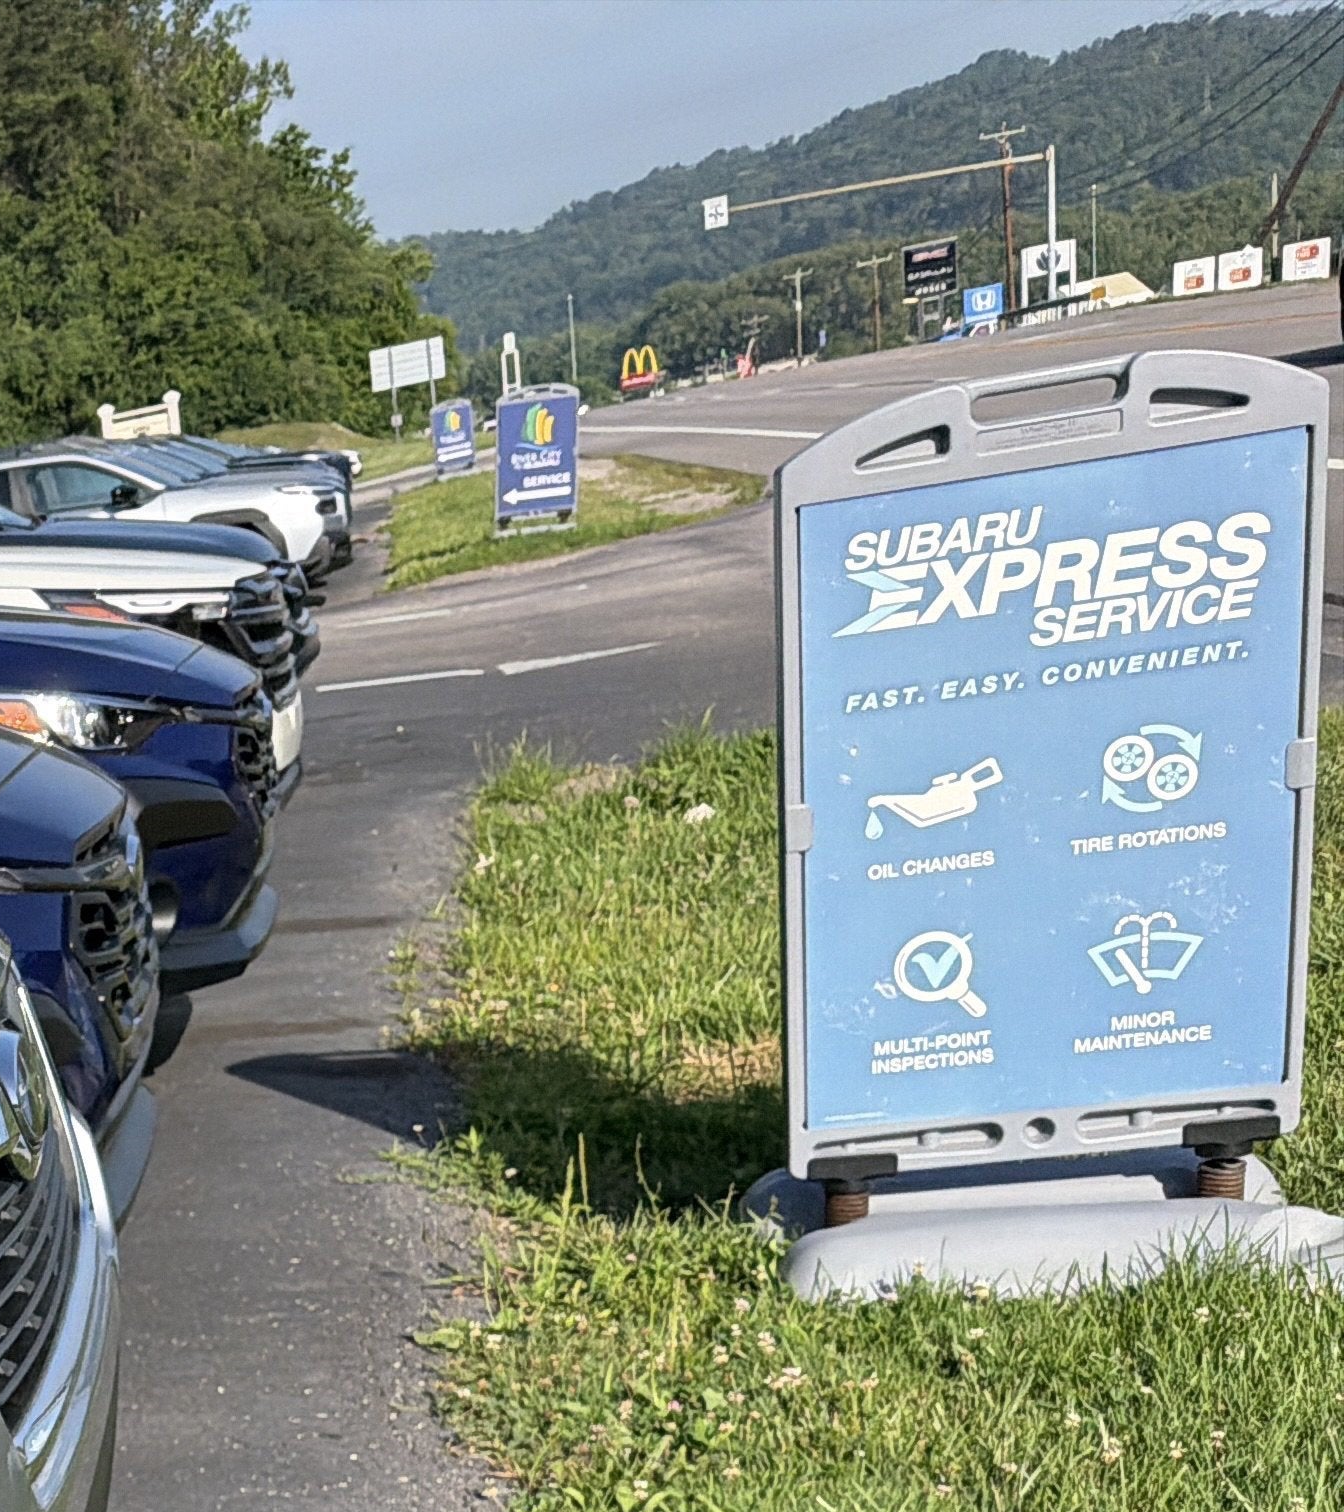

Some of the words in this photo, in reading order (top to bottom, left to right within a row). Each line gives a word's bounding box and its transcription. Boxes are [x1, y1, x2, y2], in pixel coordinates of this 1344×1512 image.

[844, 505, 1044, 572] SUBARU
[831, 511, 1272, 638] EXPRESS
[1028, 578, 1260, 649] SERVICE
[845, 685, 926, 714] FAST.
[940, 672, 1026, 699] EASY.
[1041, 640, 1250, 687] CONVENIENT.
[1070, 836, 1114, 857] TIRE
[1118, 822, 1228, 852] ROTATIONS
[866, 859, 900, 882] OIL
[902, 850, 996, 878] CHANGES
[1110, 1010, 1176, 1033] MINOR
[873, 1029, 993, 1057] MULTI-POINT
[1073, 1024, 1213, 1055] MAINTENANCE
[870, 1047, 995, 1075] INSPECTIONS
